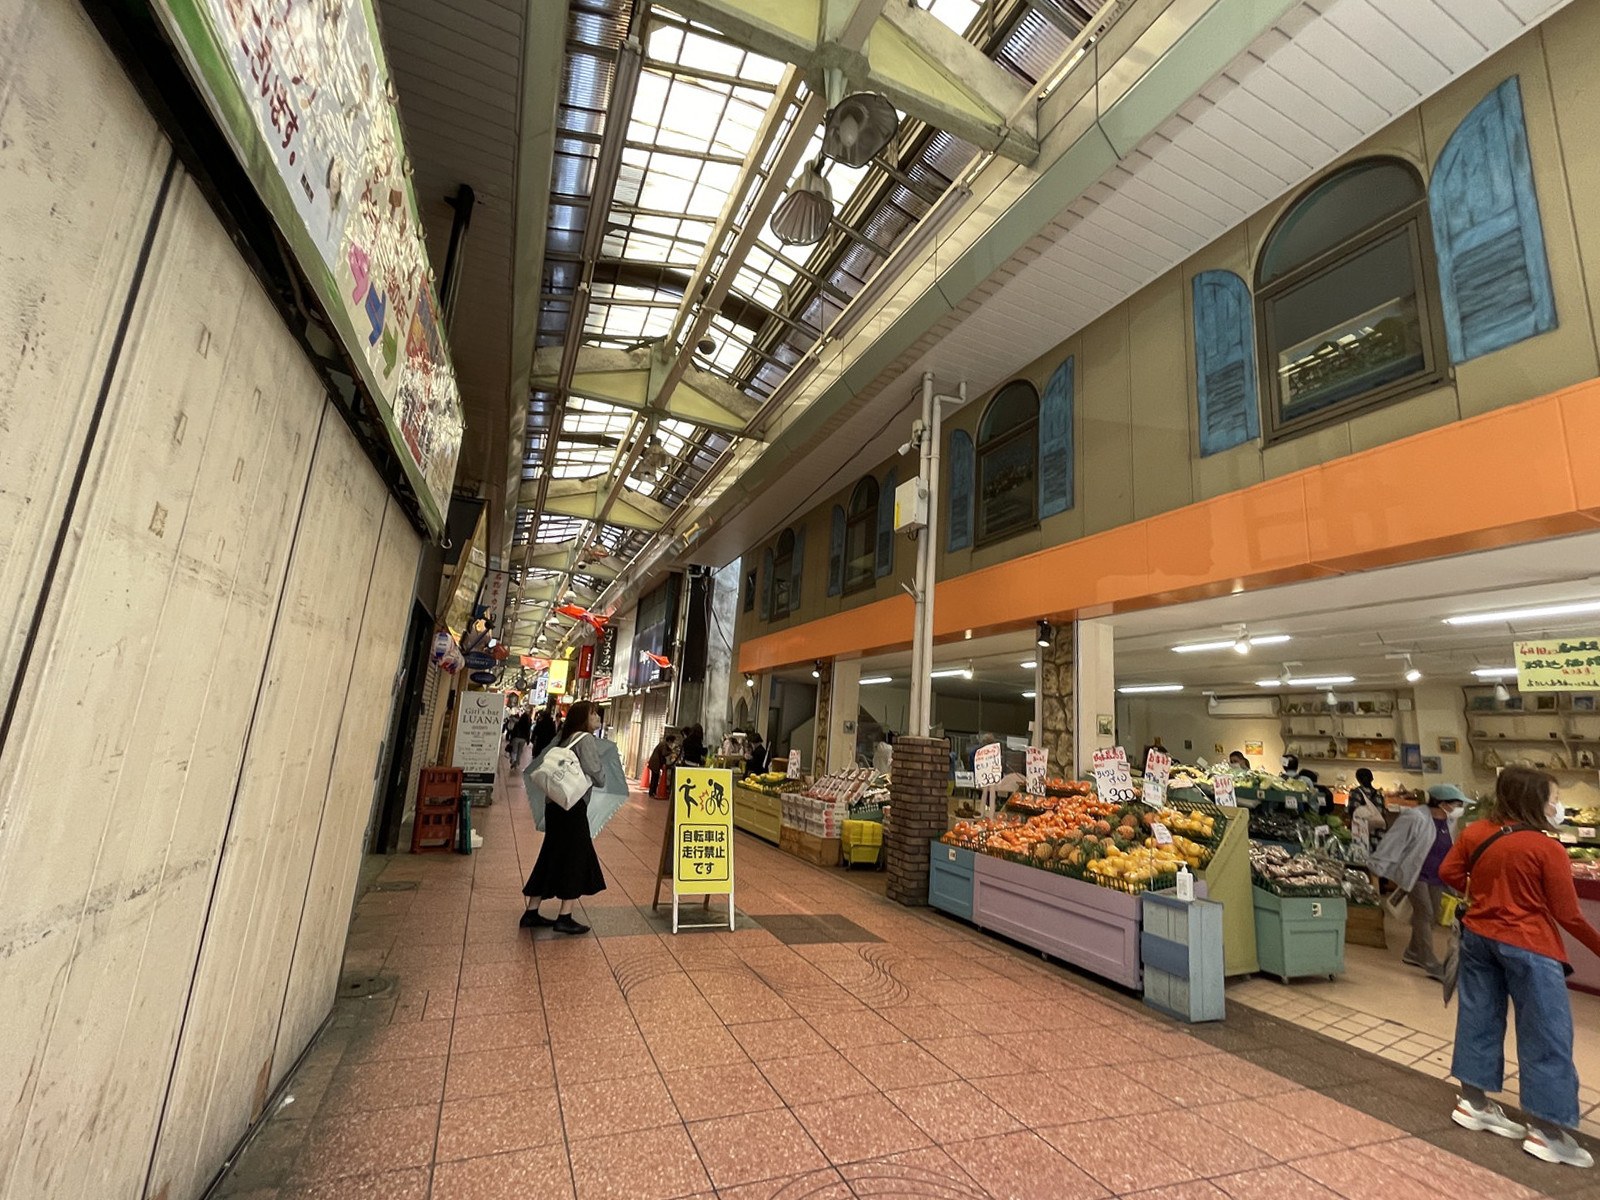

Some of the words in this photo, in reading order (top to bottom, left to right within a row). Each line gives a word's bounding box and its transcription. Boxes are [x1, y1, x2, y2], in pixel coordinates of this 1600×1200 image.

[462, 714, 500, 725] LUANA
[1109, 787, 1136, 802] 300
[682, 830, 725, 843] 自転車は
[681, 846, 726, 859] 走行禁止
[692, 862, 715, 875] です
